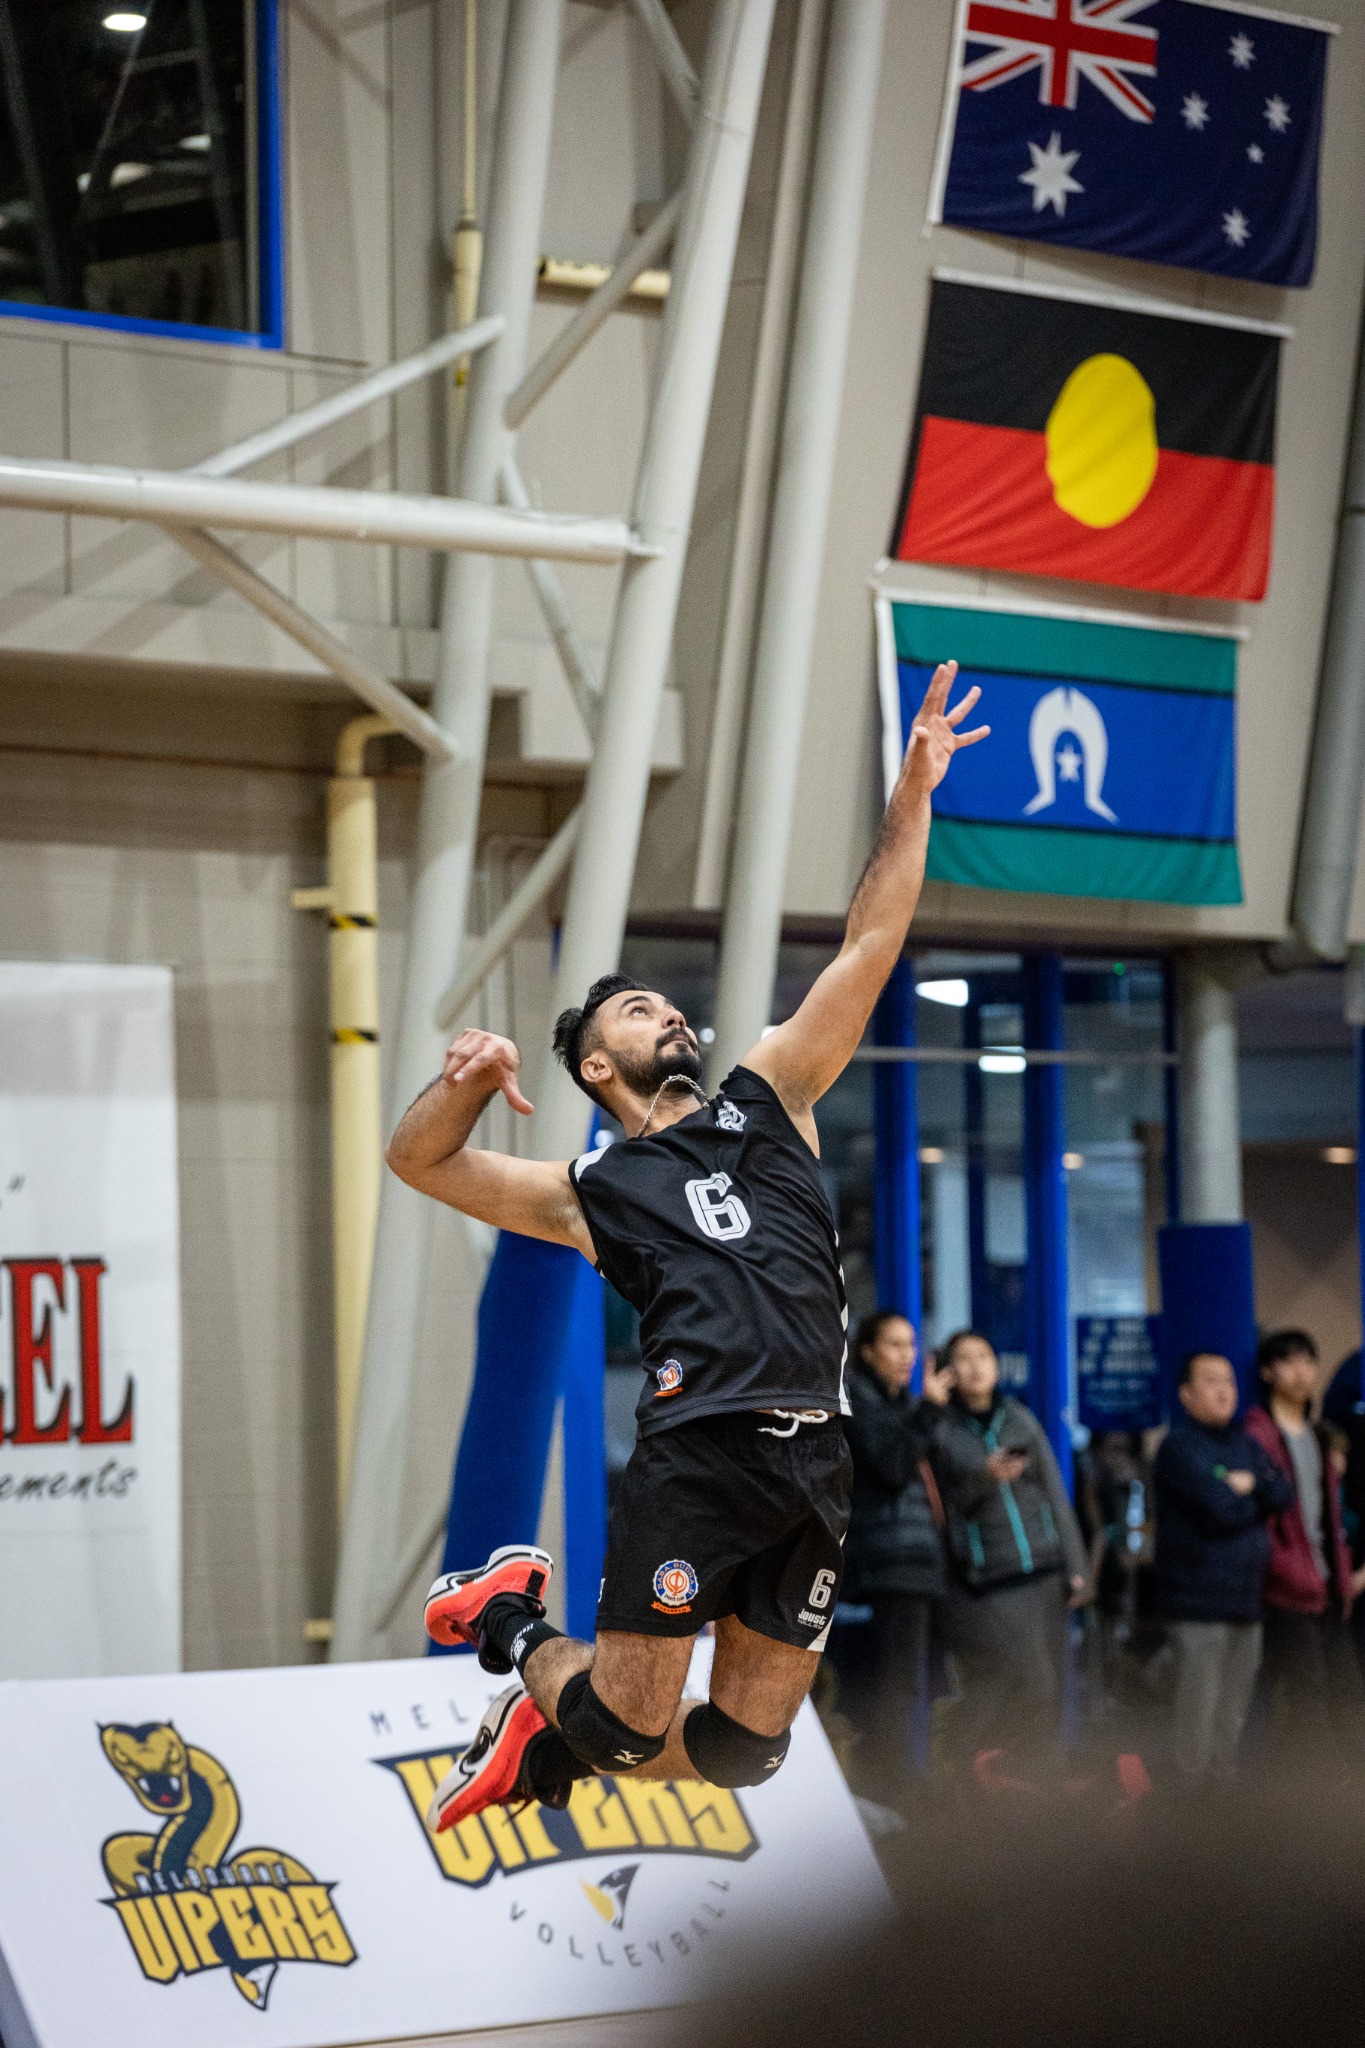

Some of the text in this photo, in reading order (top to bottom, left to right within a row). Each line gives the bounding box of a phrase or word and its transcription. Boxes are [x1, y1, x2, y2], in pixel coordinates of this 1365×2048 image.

[685, 1171, 751, 1241] 6
[0, 1256, 134, 1446] EL
[809, 1568, 836, 1609] 6
[509, 1879, 731, 1968] VOLLEYBALL
